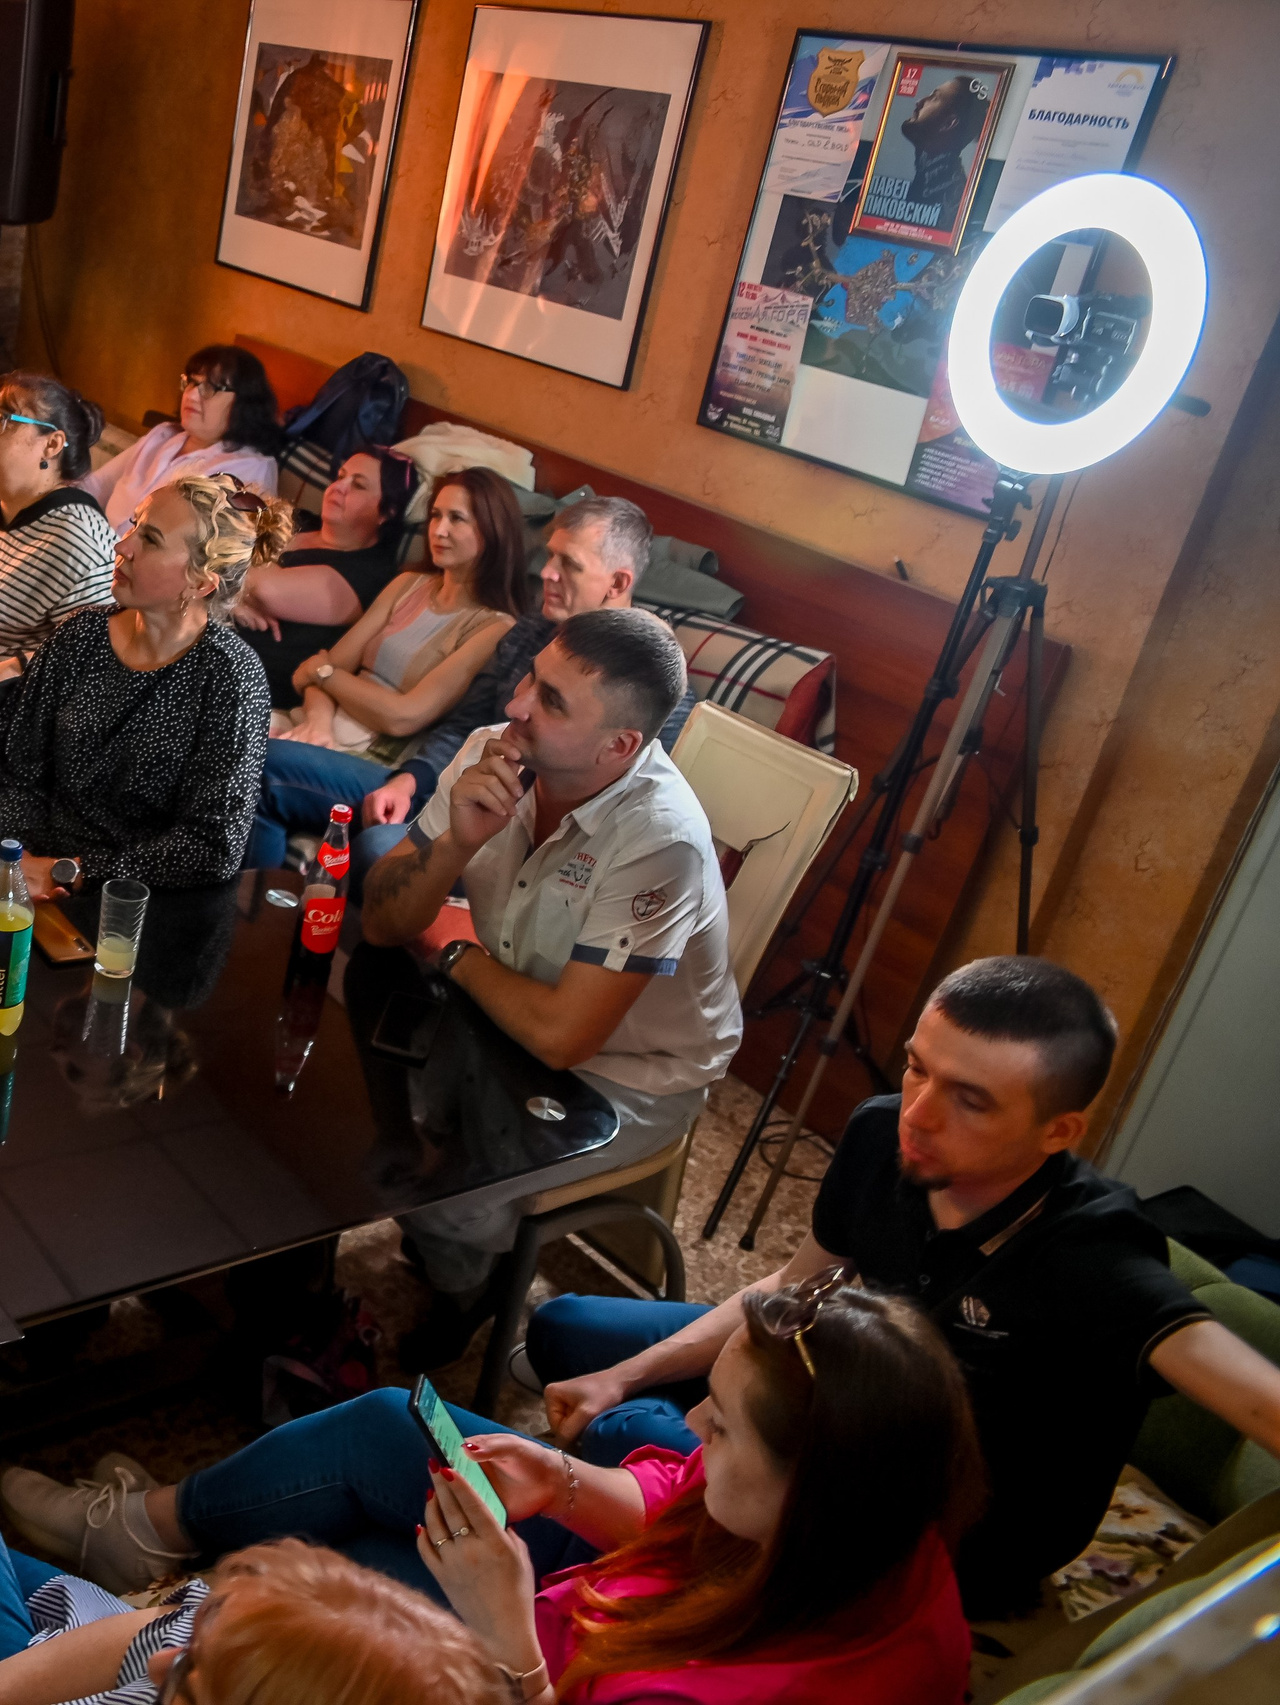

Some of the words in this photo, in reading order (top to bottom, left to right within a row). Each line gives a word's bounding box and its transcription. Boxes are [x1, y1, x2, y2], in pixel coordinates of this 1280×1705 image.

[907, 68, 918, 79] 17
[1028, 108, 1130, 130] БЛАГОДАРНОСТЬ
[869, 175, 912, 200] ПАВЕЛ
[864, 195, 942, 227] ПИКОВСКИЙ
[737, 281, 746, 297] 12
[304, 909, 343, 924] Cola
